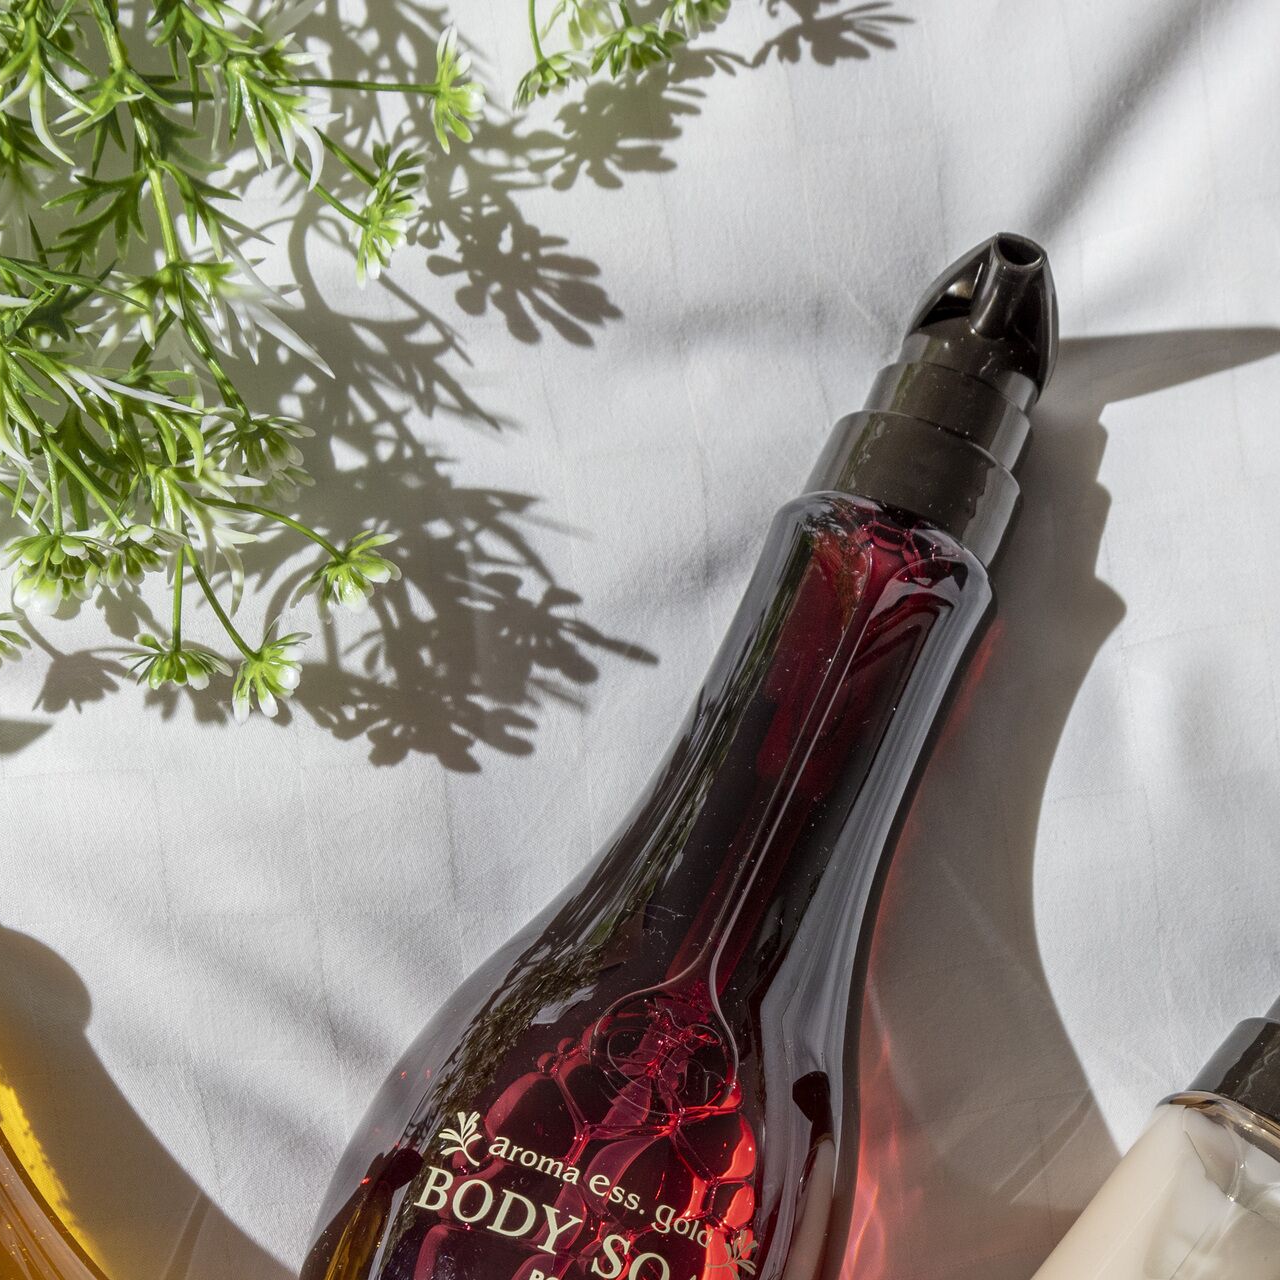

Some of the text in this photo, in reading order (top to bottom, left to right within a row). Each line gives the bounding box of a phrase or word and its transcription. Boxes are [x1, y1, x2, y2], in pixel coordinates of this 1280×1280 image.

[413, 1165, 583, 1256] BODY
[487, 1134, 714, 1249] aroma ess. gold
